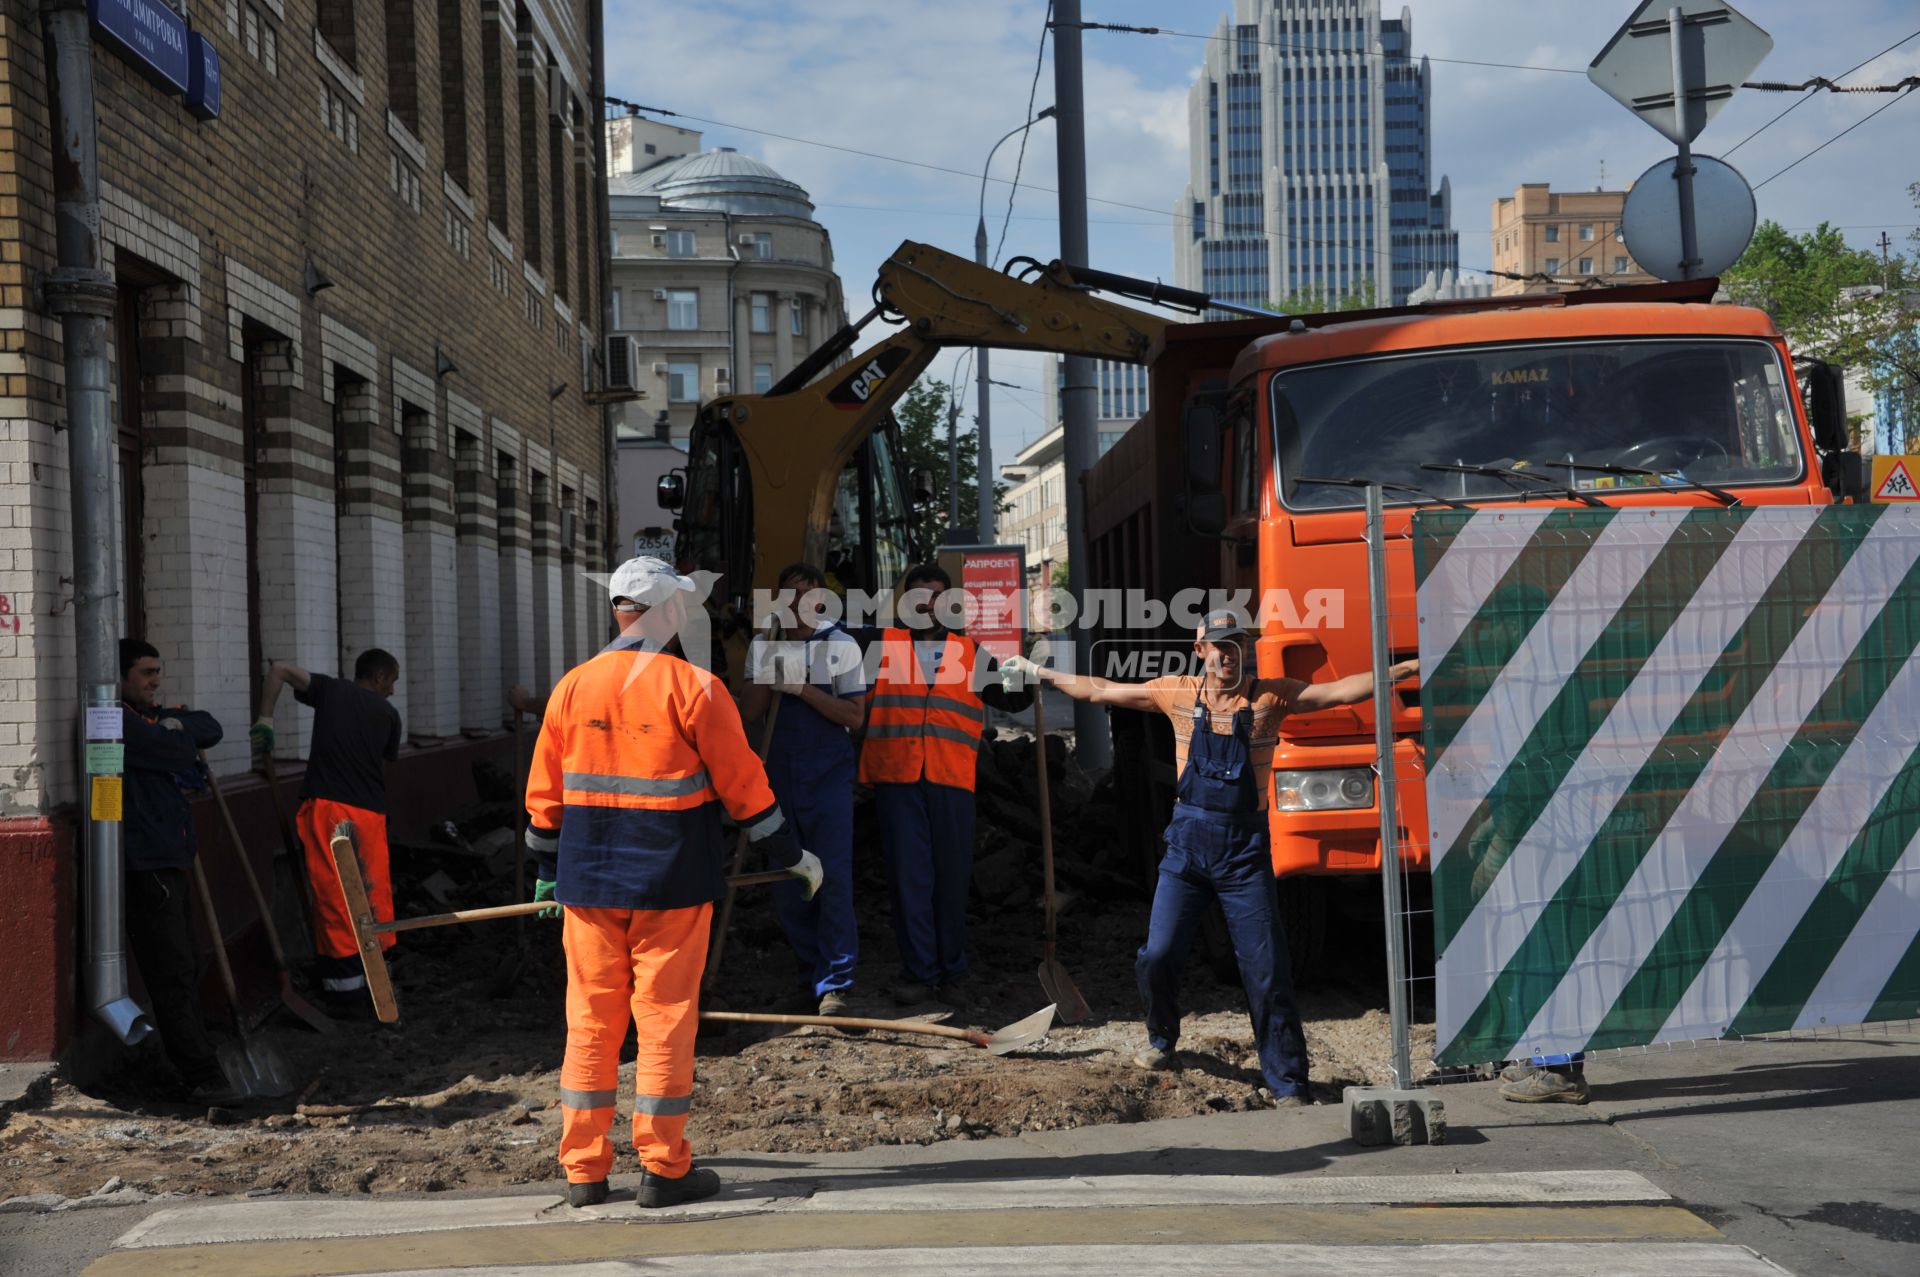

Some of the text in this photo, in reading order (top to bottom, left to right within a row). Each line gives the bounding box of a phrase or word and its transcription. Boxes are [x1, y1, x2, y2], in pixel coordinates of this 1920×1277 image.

[132, 0, 183, 54] ДМИТРОВКА
[851, 359, 887, 400] CAT
[1491, 368, 1549, 384] KAMAZ
[639, 536, 670, 549] 2654
